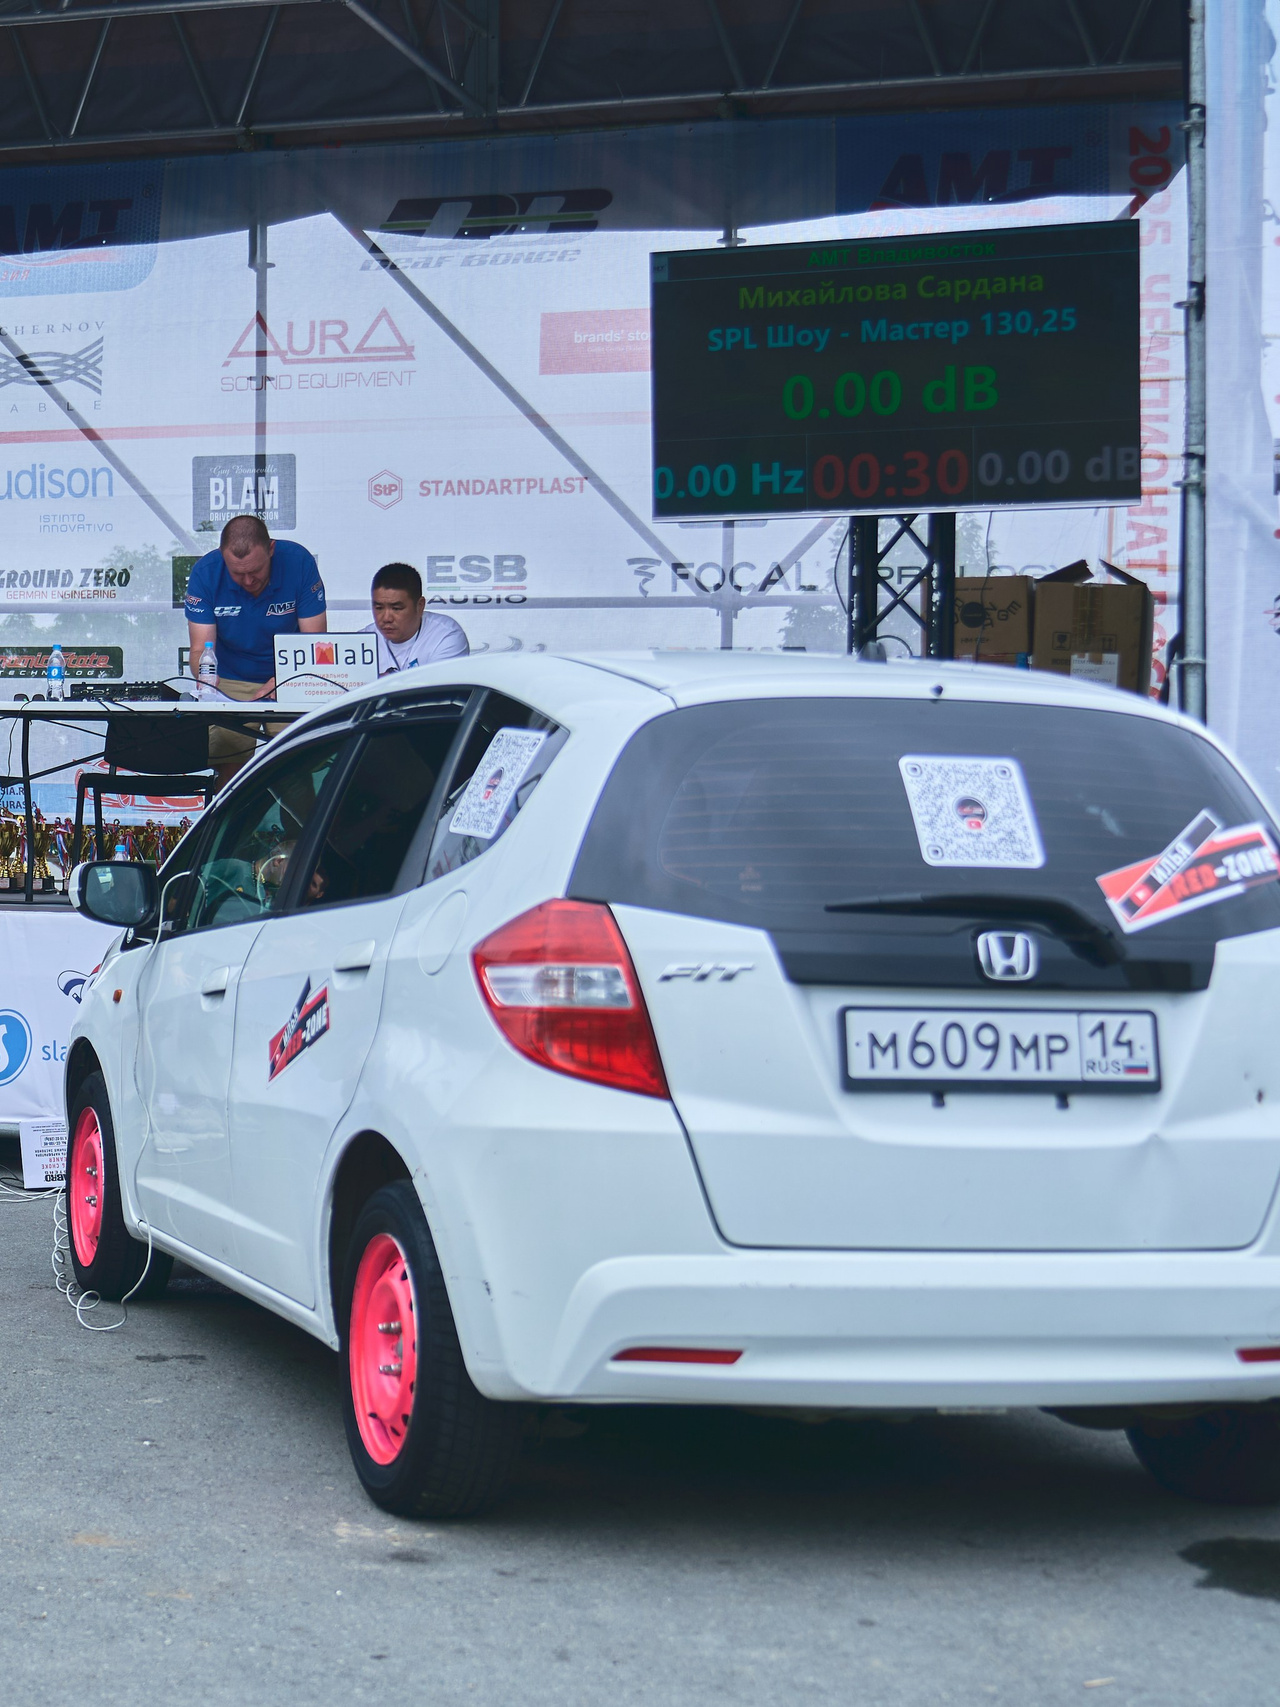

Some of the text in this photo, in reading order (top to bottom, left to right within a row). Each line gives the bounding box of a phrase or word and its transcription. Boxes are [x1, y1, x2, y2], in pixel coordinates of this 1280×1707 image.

[857, 240, 996, 264] Владивосток
[738, 273, 1045, 310] Михайлова Сардана
[628, 328, 651, 342] sto
[708, 328, 757, 352] SPL
[766, 322, 831, 353] Шоу
[860, 314, 970, 345] Мастер
[982, 307, 1078, 338] 130,25
[221, 370, 417, 392] SOUND EQUIPMENT
[782, 364, 999, 421] 0.00 dB
[812, 448, 970, 501] 00:30
[978, 445, 1140, 486] 0.00 dB
[373, 483, 399, 496] StP
[419, 476, 588, 497] STANDARTPLAST
[655, 461, 805, 498] 0.00 Hz
[209, 475, 279, 511] BLAM
[39, 513, 85, 523] ISTINTO
[39, 523, 114, 533] INNOVATIVO
[78, 567, 131, 588] ZERO
[426, 554, 528, 584] ESB
[670, 561, 817, 593] FOCAL
[6, 589, 117, 600] GERMAN ENGINEERING
[426, 594, 528, 605] AUDIO
[1150, 841, 1196, 885] ИЛЬЯ
[659, 963, 755, 983] FIT
[41, 1040, 67, 1062] sla
[1087, 1021, 1136, 1059] 14
[1086, 1060, 1122, 1074] RUS
